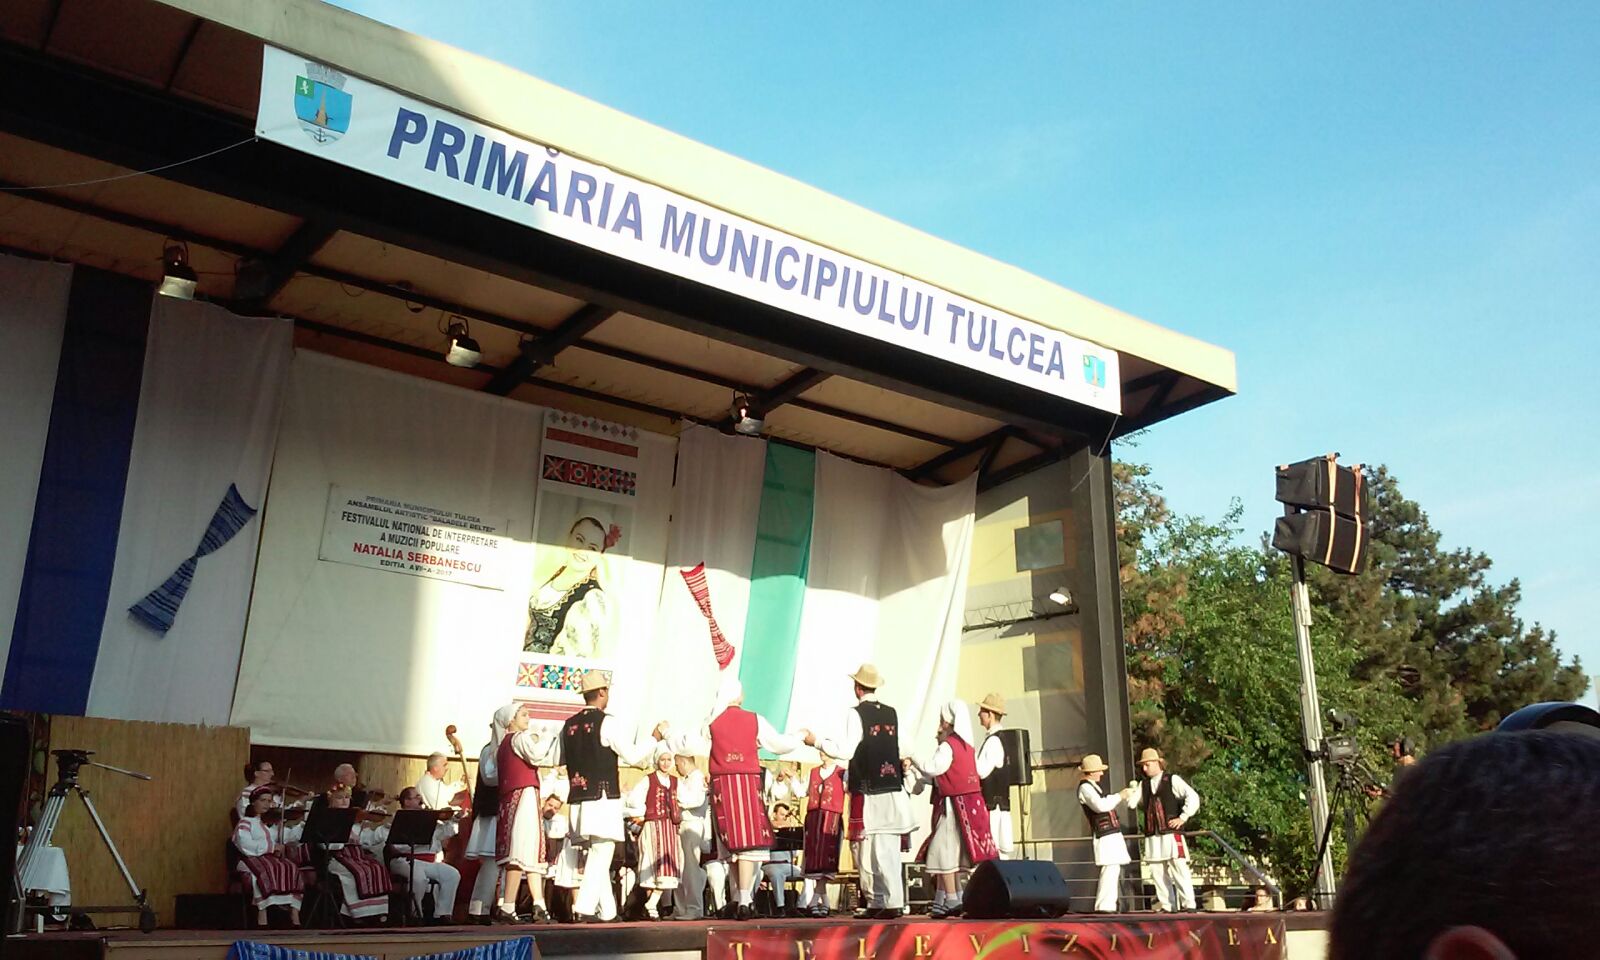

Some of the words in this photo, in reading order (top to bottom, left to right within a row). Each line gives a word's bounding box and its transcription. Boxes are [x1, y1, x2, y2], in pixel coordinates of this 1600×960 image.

[387, 107, 643, 241] PRIMĂRIA
[659, 203, 934, 336] MUNICIPIULUI
[946, 303, 1066, 380] TULCEA
[341, 510, 390, 529] FESTIVALUL
[391, 519, 431, 537] NATIONAL
[432, 528, 443, 539] DE
[444, 530, 499, 549] INTERPRETARE
[380, 532, 386, 542] A
[387, 533, 419, 548] MUZICII
[420, 538, 461, 555] POPULARE
[353, 542, 404, 561] NATALIA
[407, 551, 482, 573] SERBANESCU
[380, 559, 405, 569] EDITIA
